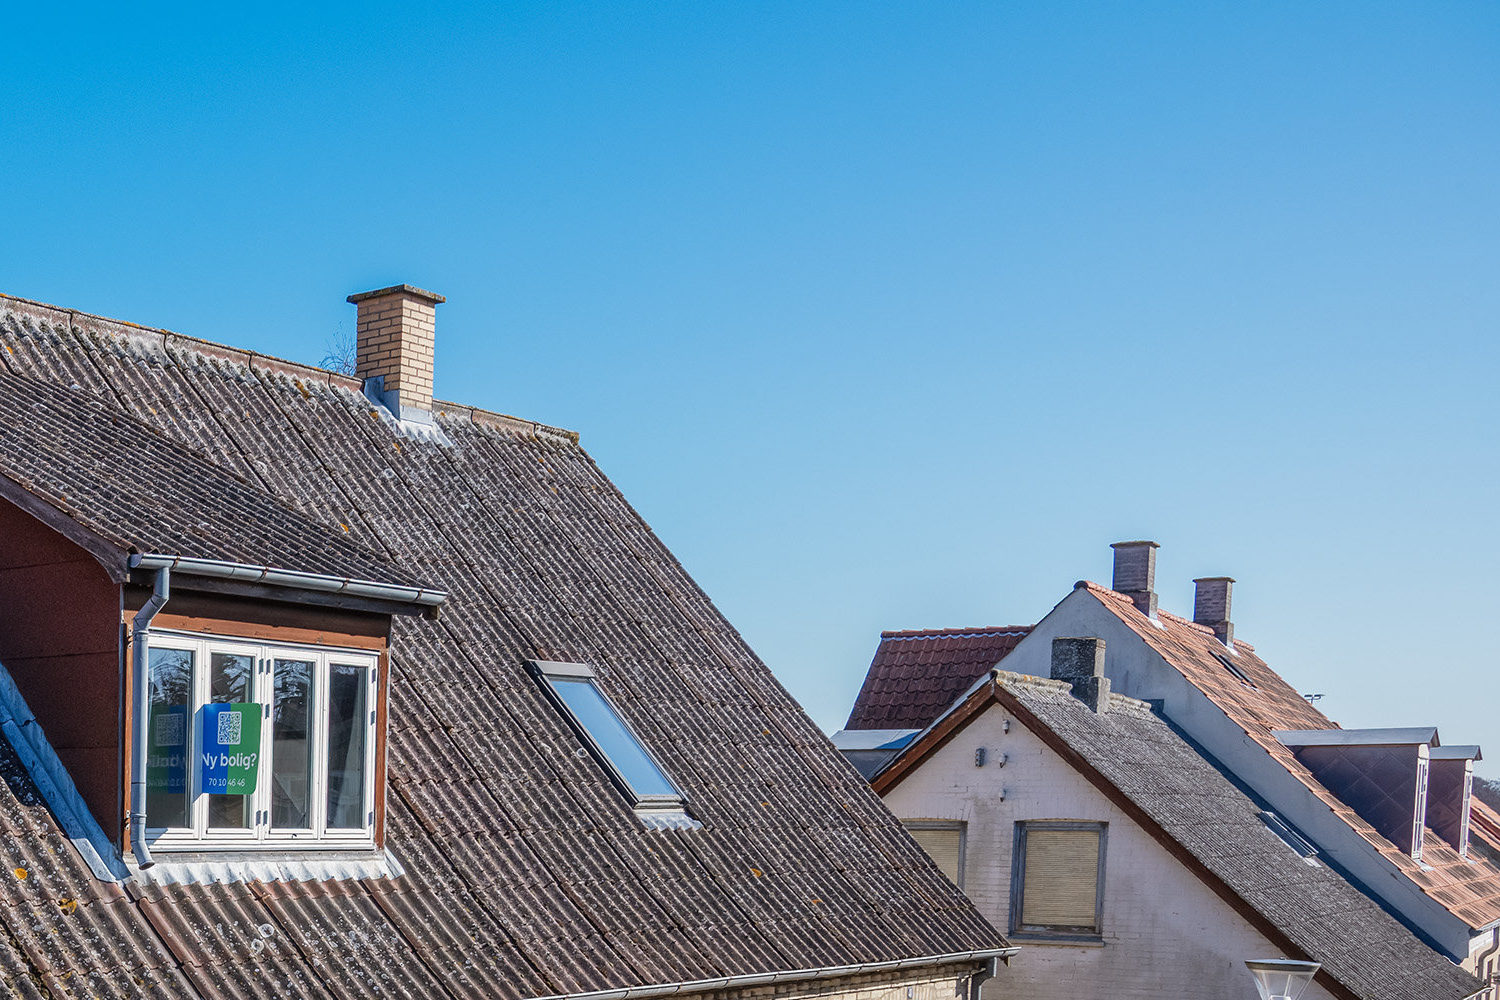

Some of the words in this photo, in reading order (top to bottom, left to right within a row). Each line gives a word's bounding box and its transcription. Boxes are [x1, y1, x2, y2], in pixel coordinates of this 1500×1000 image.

[202, 752, 218, 770] Ny
[220, 752, 257, 770] bolig?
[208, 777, 217, 787] 70
[218, 777, 227, 787] 10
[227, 778, 236, 787] 46
[237, 778, 246, 787] 46
